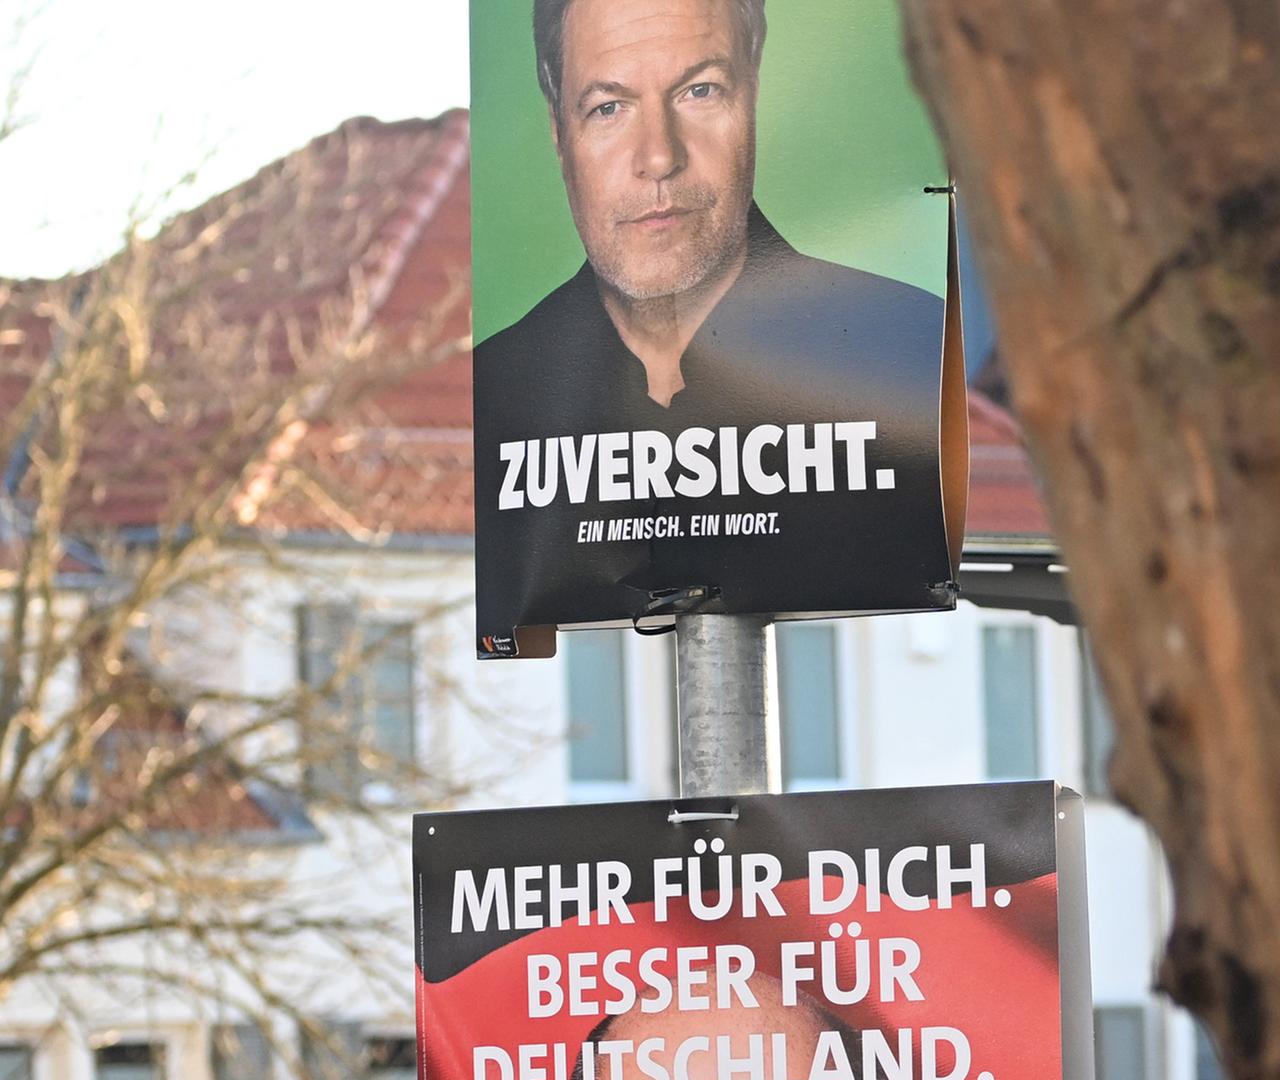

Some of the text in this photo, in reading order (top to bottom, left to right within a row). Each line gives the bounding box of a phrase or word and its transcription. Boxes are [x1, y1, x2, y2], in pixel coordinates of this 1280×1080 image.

[498, 420, 896, 511] ZUVERSICHT.
[577, 512, 780, 544] EIN MENSCH. EIN WORT.
[451, 838, 1011, 933] MEHR FÜR DICH.
[527, 922, 926, 1018] BESSER FÜR
